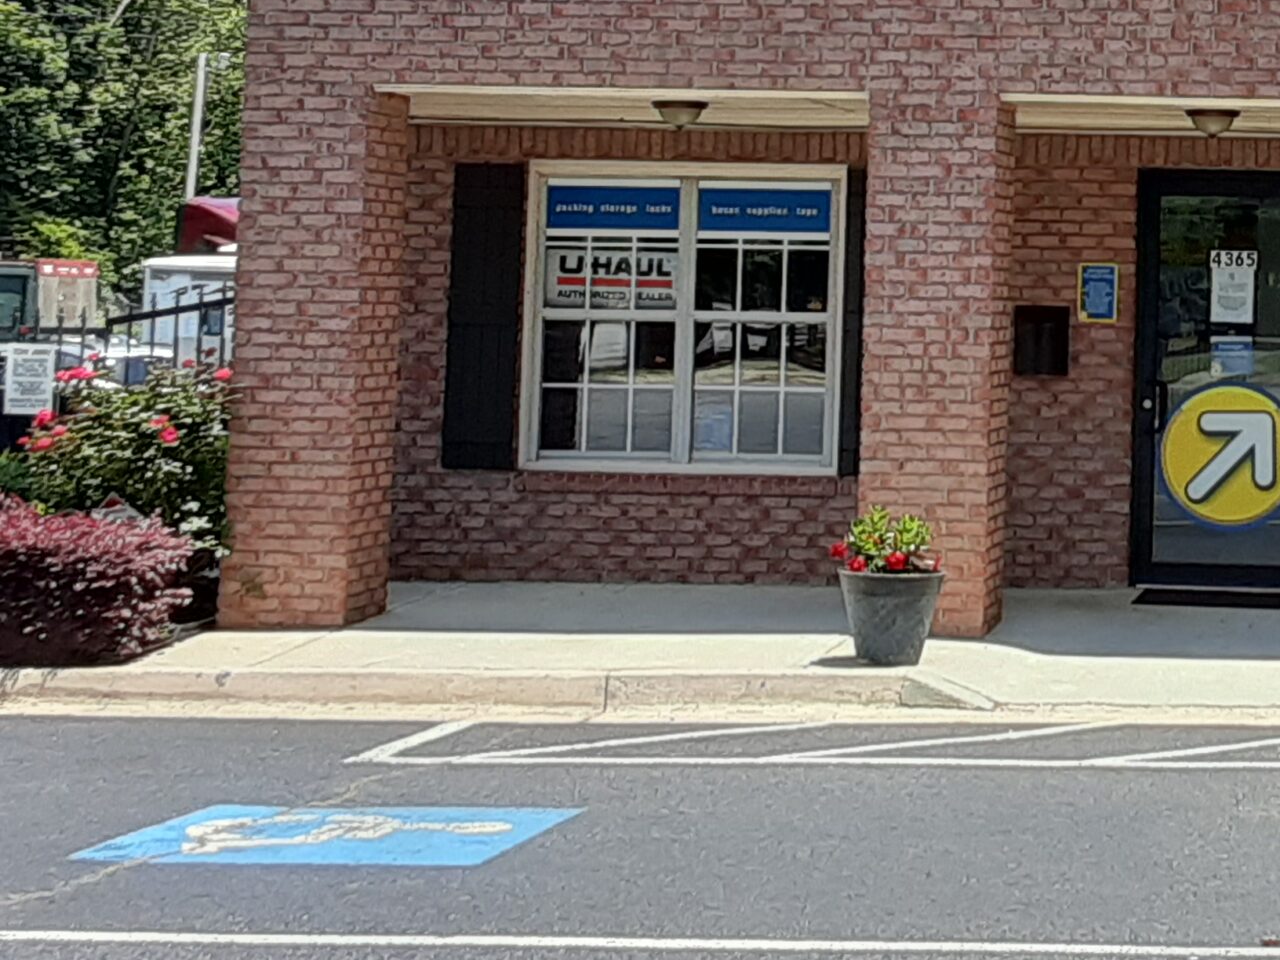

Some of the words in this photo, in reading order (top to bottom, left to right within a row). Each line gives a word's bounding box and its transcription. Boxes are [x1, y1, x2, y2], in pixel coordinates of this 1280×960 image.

[559, 254, 672, 278] UHAUL
[1211, 251, 1256, 268] 4365
[632, 292, 673, 302] EALER
